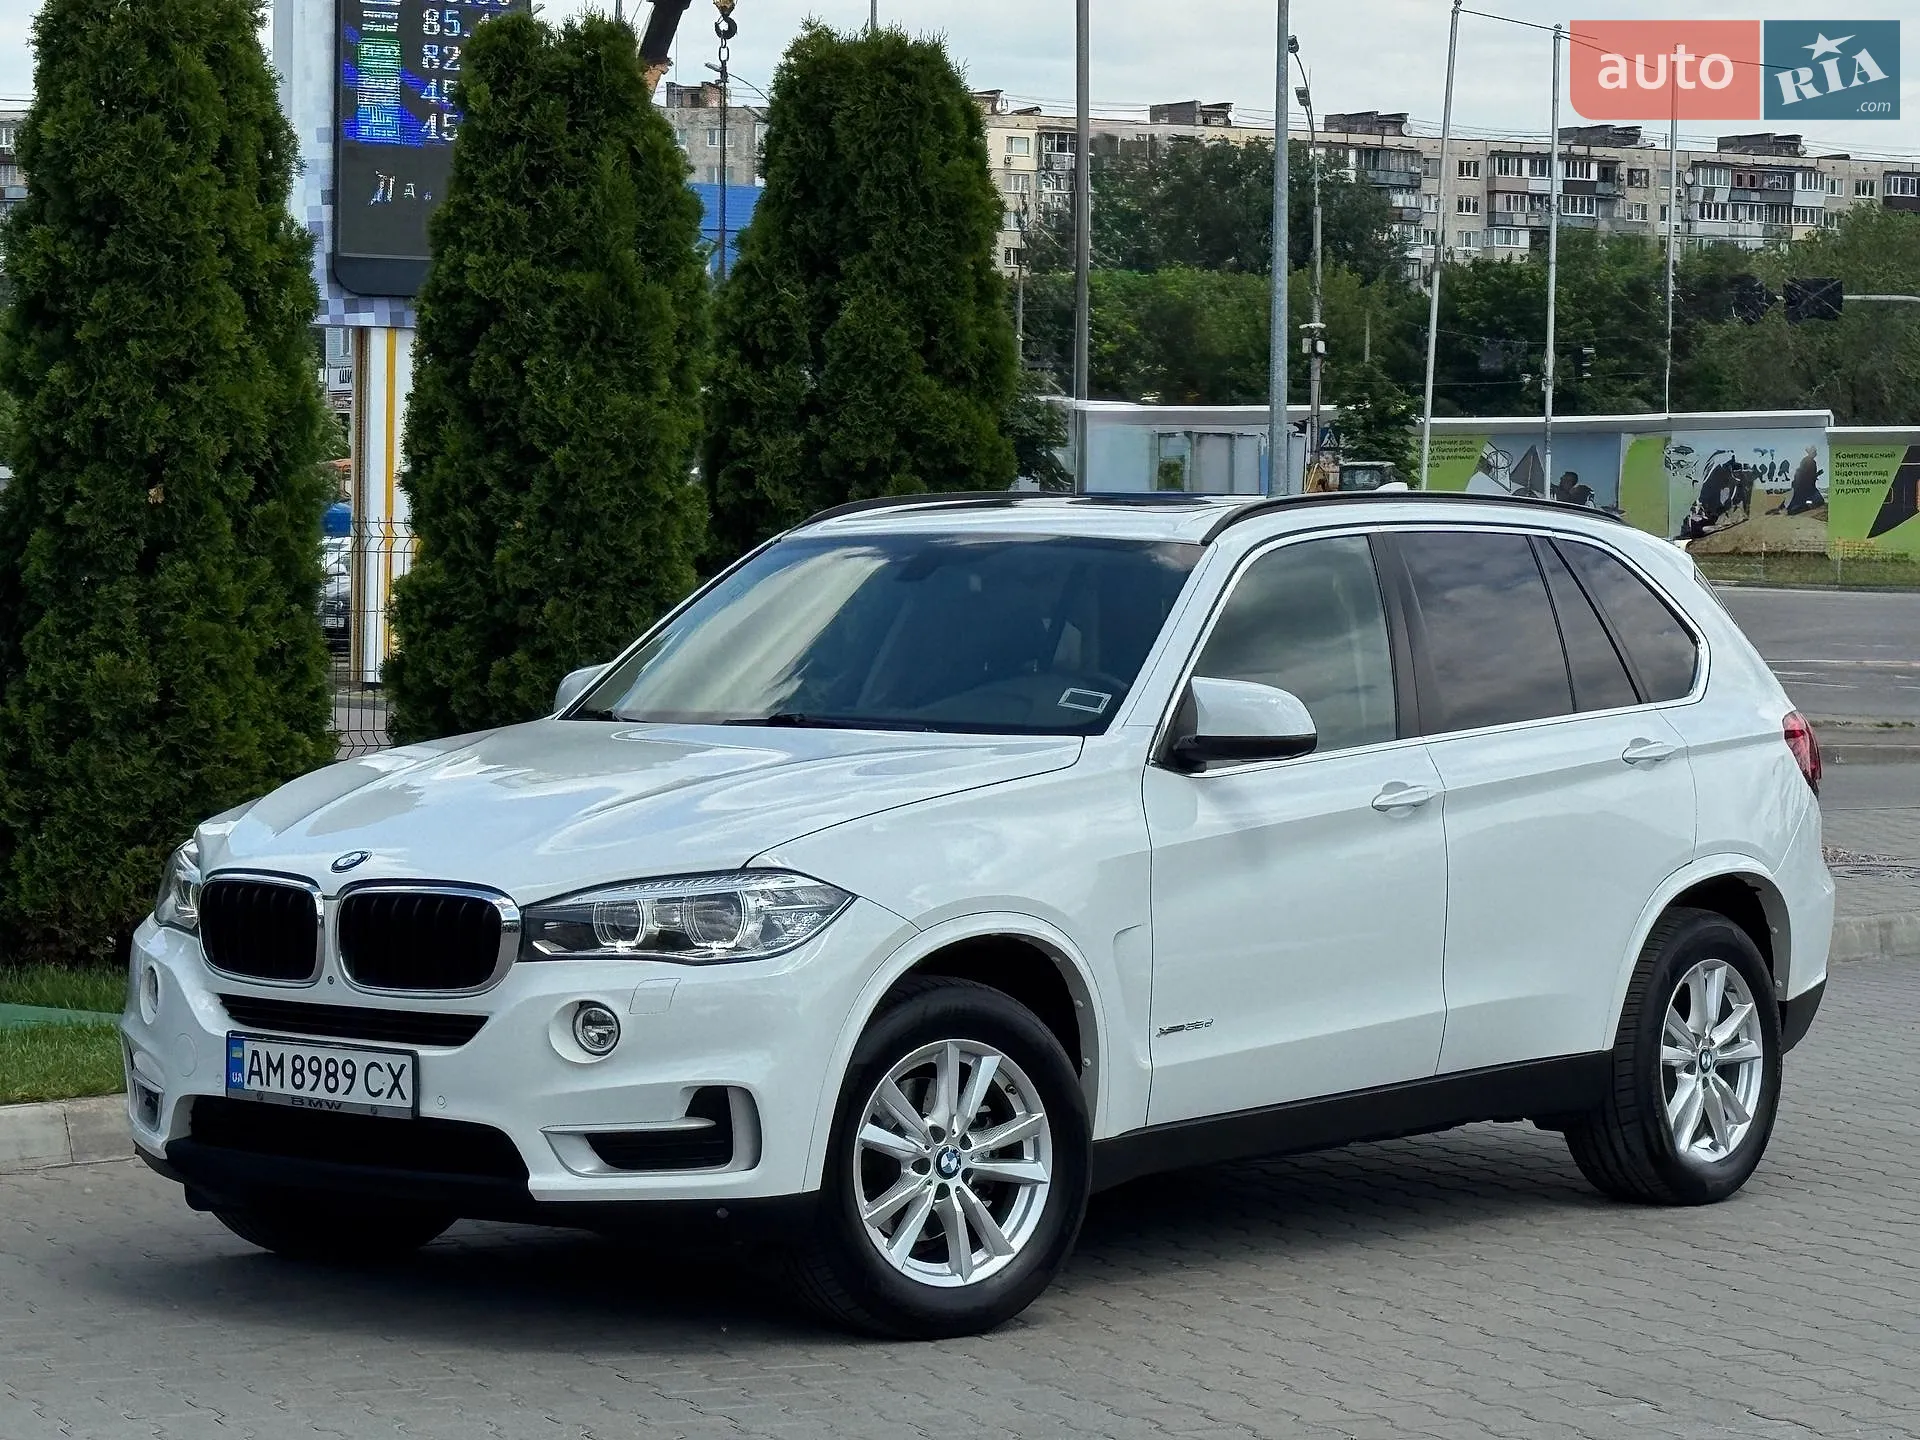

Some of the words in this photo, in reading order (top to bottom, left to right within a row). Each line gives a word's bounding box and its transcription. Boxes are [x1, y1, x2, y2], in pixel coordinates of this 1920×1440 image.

[231, 1071, 243, 1083] UA
[246, 1049, 285, 1089] AM
[290, 1054, 357, 1096] 8989
[363, 1061, 407, 1101] CX
[291, 1096, 342, 1110] BMW
